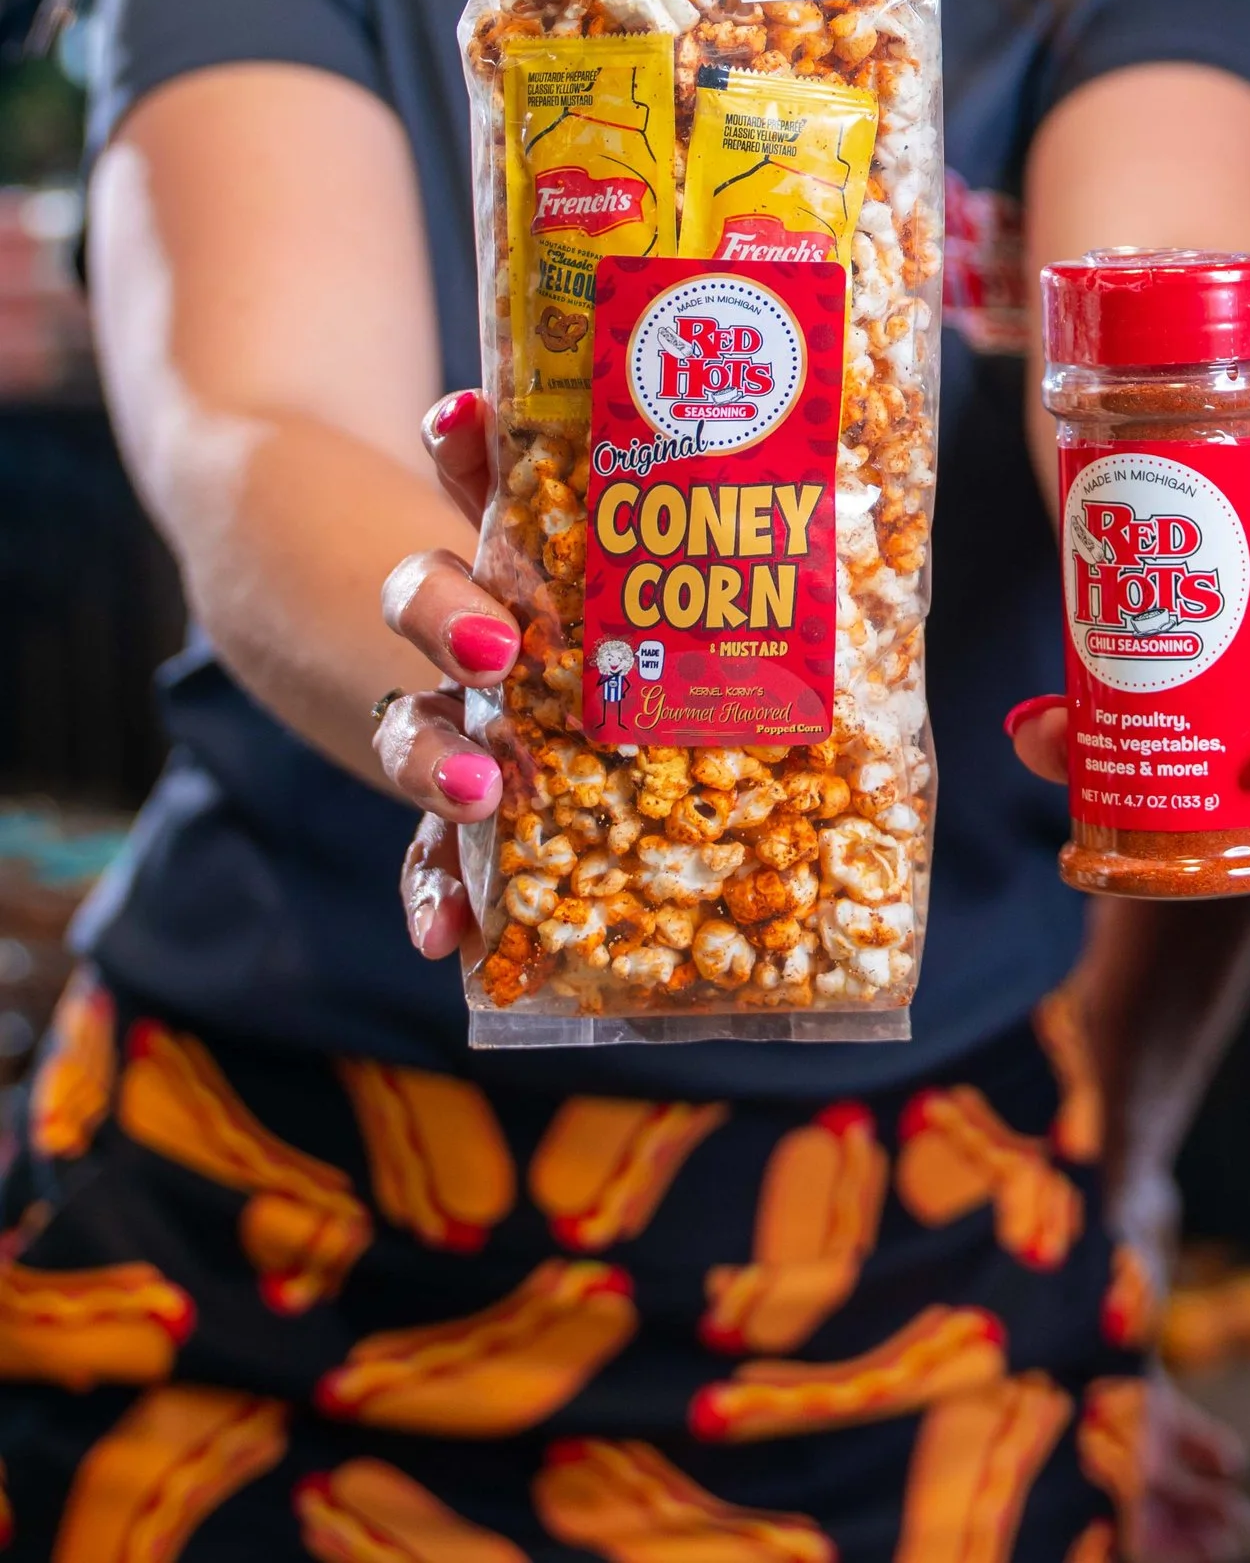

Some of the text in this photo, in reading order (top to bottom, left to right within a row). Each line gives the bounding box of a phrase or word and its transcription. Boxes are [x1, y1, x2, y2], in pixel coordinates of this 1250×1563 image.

[528, 71, 565, 83] MOUTARDE
[527, 83, 554, 95] CLASSIC
[527, 94, 593, 107] PREPARED MUSTARD
[725, 113, 766, 128] MOUTARDE
[724, 125, 755, 140] CLASSIC
[722, 138, 797, 157] PREPARED MUSTARD
[536, 186, 632, 218] French's
[720, 232, 824, 262] French's
[676, 295, 762, 316] MADE IN MICHIGAN
[674, 316, 763, 359] RED
[684, 406, 747, 418] SEASONING
[594, 419, 708, 475] Original
[1083, 469, 1197, 498] MADE IN MICHIGAN
[595, 480, 824, 559] CONEY
[1082, 499, 1202, 567] RED
[622, 561, 798, 630] CORN
[641, 648, 660, 657] MADE
[709, 641, 789, 657] & MUSTARD
[1089, 635, 1194, 653] CHILI SEASONING
[641, 660, 659, 669] WITH
[689, 686, 722, 696] KERNEL
[635, 685, 793, 730] Gourmet Flavored
[756, 723, 822, 735] Popped Corn
[1095, 709, 1191, 732] For poultry,
[1076, 731, 1226, 756] meats, vegetables,
[1085, 757, 1209, 777] sauces & more!
[1081, 788, 1220, 811] NET WT. 4.7 OZ (133 g)
